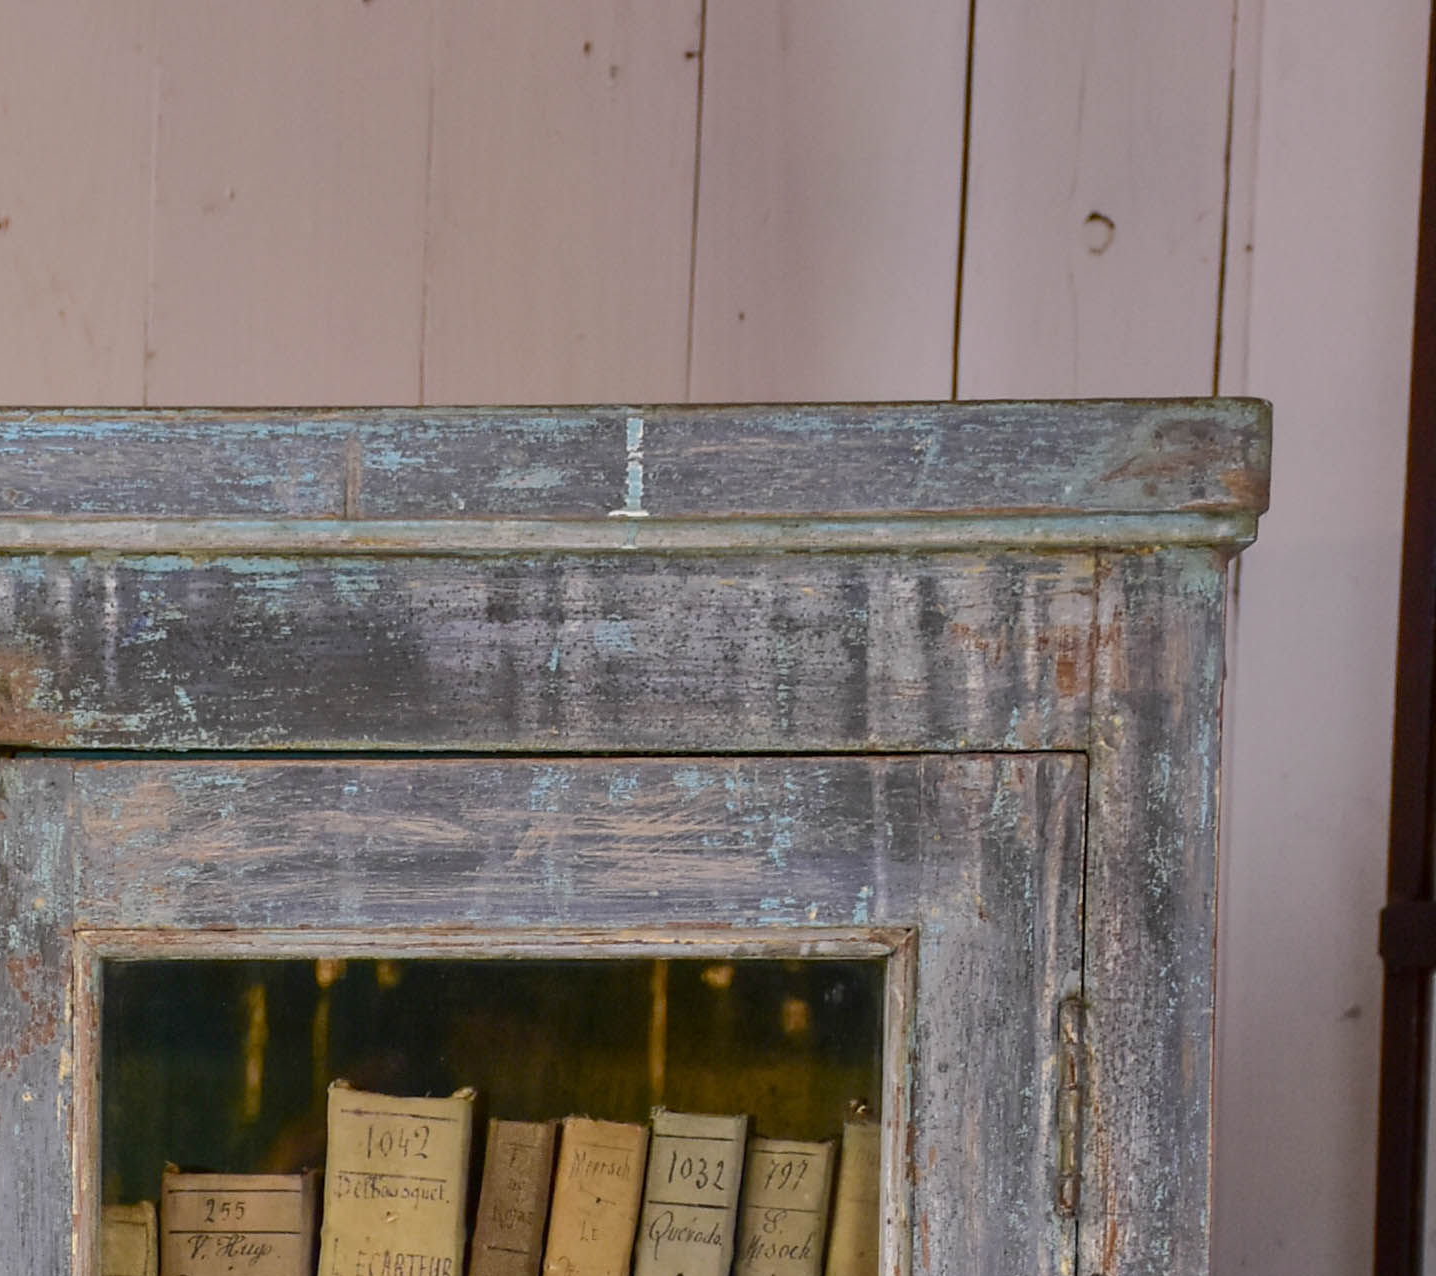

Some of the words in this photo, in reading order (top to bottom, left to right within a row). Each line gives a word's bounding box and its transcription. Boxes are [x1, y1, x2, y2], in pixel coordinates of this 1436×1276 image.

[365, 1123, 430, 1160] 1042
[668, 1150, 725, 1191] 1032
[203, 1198, 246, 1223] 255
[578, 1219, 599, 1242] LE
